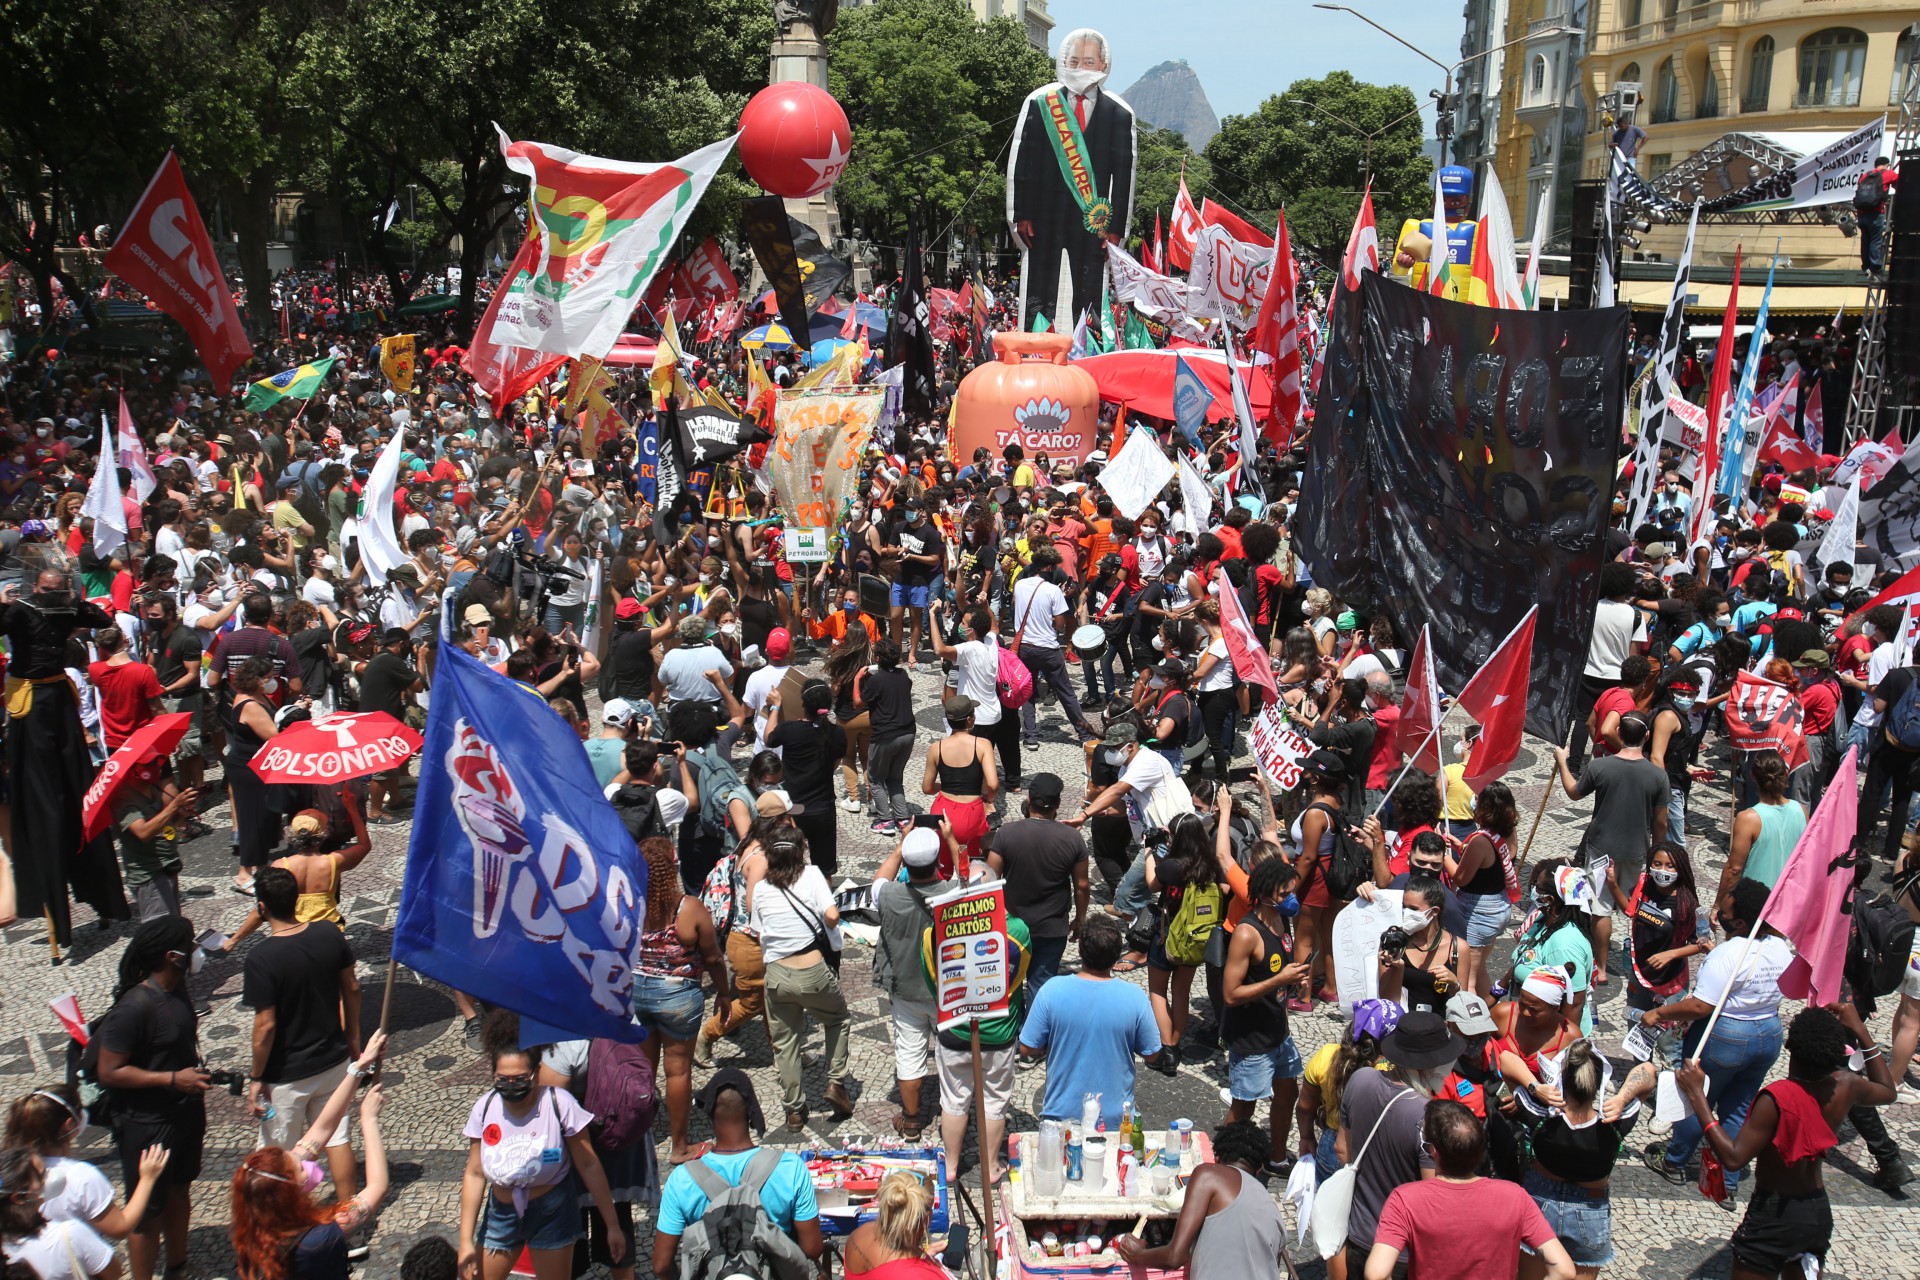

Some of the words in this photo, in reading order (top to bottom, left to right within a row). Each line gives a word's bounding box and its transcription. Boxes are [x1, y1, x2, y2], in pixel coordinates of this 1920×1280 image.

[1045, 94, 1074, 144] LULA
[1063, 143, 1093, 198] LIVRE
[822, 162, 843, 179] PT
[129, 242, 159, 272] CENTRAL
[157, 267, 180, 292] ÚNICA
[178, 287, 196, 306] DOS
[688, 415, 741, 434] LEVANTE
[996, 430, 1022, 447] TÁ
[1025, 434, 1082, 449] CARO?
[798, 535, 814, 544] BR
[787, 550, 828, 558] PETROBRAS
[1262, 702, 1314, 758] RESPEITEM
[259, 735, 411, 778] BOLSONARO
[940, 896, 996, 923] ACEITAMOS
[945, 916, 992, 938] CARTÕES
[976, 943, 997, 952] Maestro
[945, 971, 961, 979] VISA
[979, 965, 997, 974] VISA
[985, 984, 1002, 994] elo
[952, 1009, 958, 1017] E
[958, 1003, 989, 1013] OUTROS
